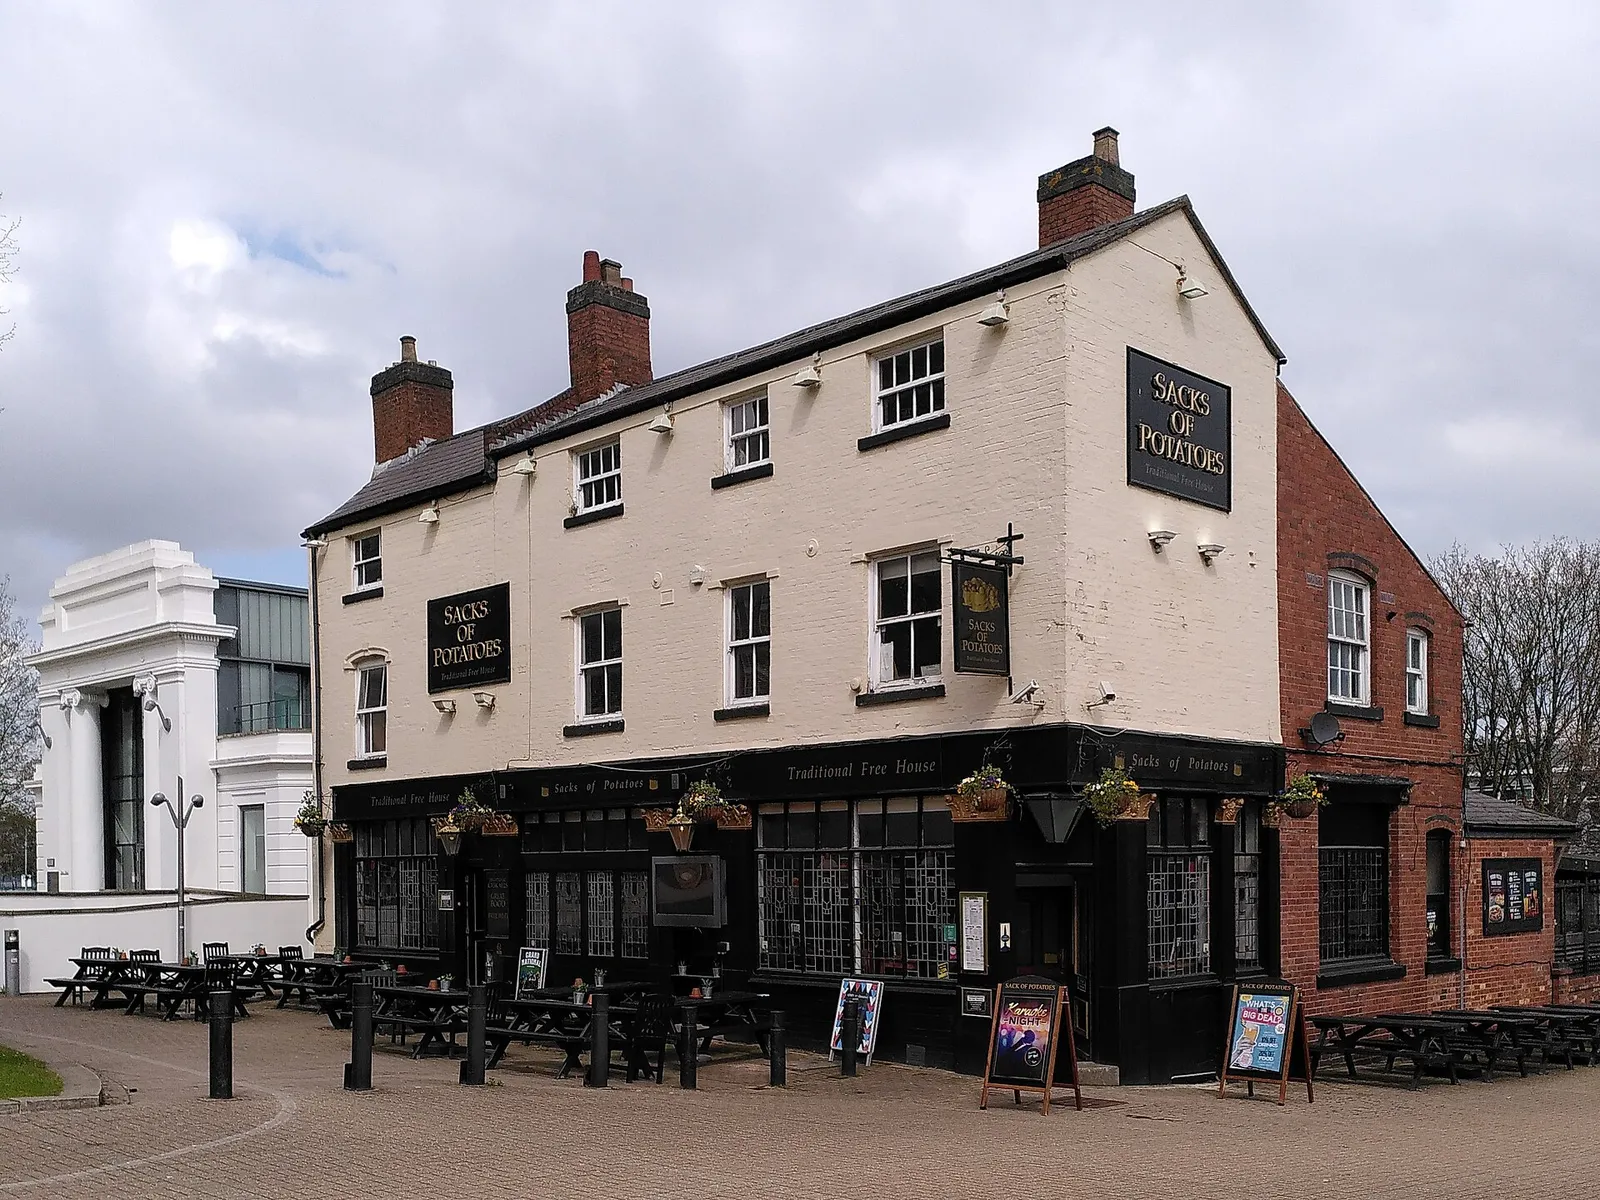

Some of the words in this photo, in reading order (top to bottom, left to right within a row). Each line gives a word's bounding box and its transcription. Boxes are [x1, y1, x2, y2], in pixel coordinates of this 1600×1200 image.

[1153, 372, 1210, 416] SACKS
[1170, 410, 1195, 437] OF
[1138, 423, 1225, 475] POTATOES
[444, 600, 489, 625] SACKS
[457, 623, 476, 642] OF
[968, 619, 995, 632] SACKS
[976, 632, 988, 642] OF
[433, 639, 503, 667] POTATOES
[962, 640, 1003, 654] POTATOES
[787, 763, 853, 780] Traditional
[861, 761, 887, 776] Free
[896, 758, 936, 774] House
[1132, 753, 1160, 767] Sacks
[1169, 756, 1180, 772] of
[1189, 757, 1229, 771] Potatoes
[554, 782, 578, 793] Sacks
[586, 780, 596, 793] of
[604, 779, 644, 790] Potatoes
[371, 794, 407, 806] Traditional
[410, 793, 425, 804] Free
[428, 791, 450, 803] House
[1005, 1002, 1048, 1017] Karaoke
[1246, 1000, 1276, 1008] WHAT'S
[1242, 1010, 1256, 1019] BIG
[1257, 1013, 1282, 1024] DEAL?
